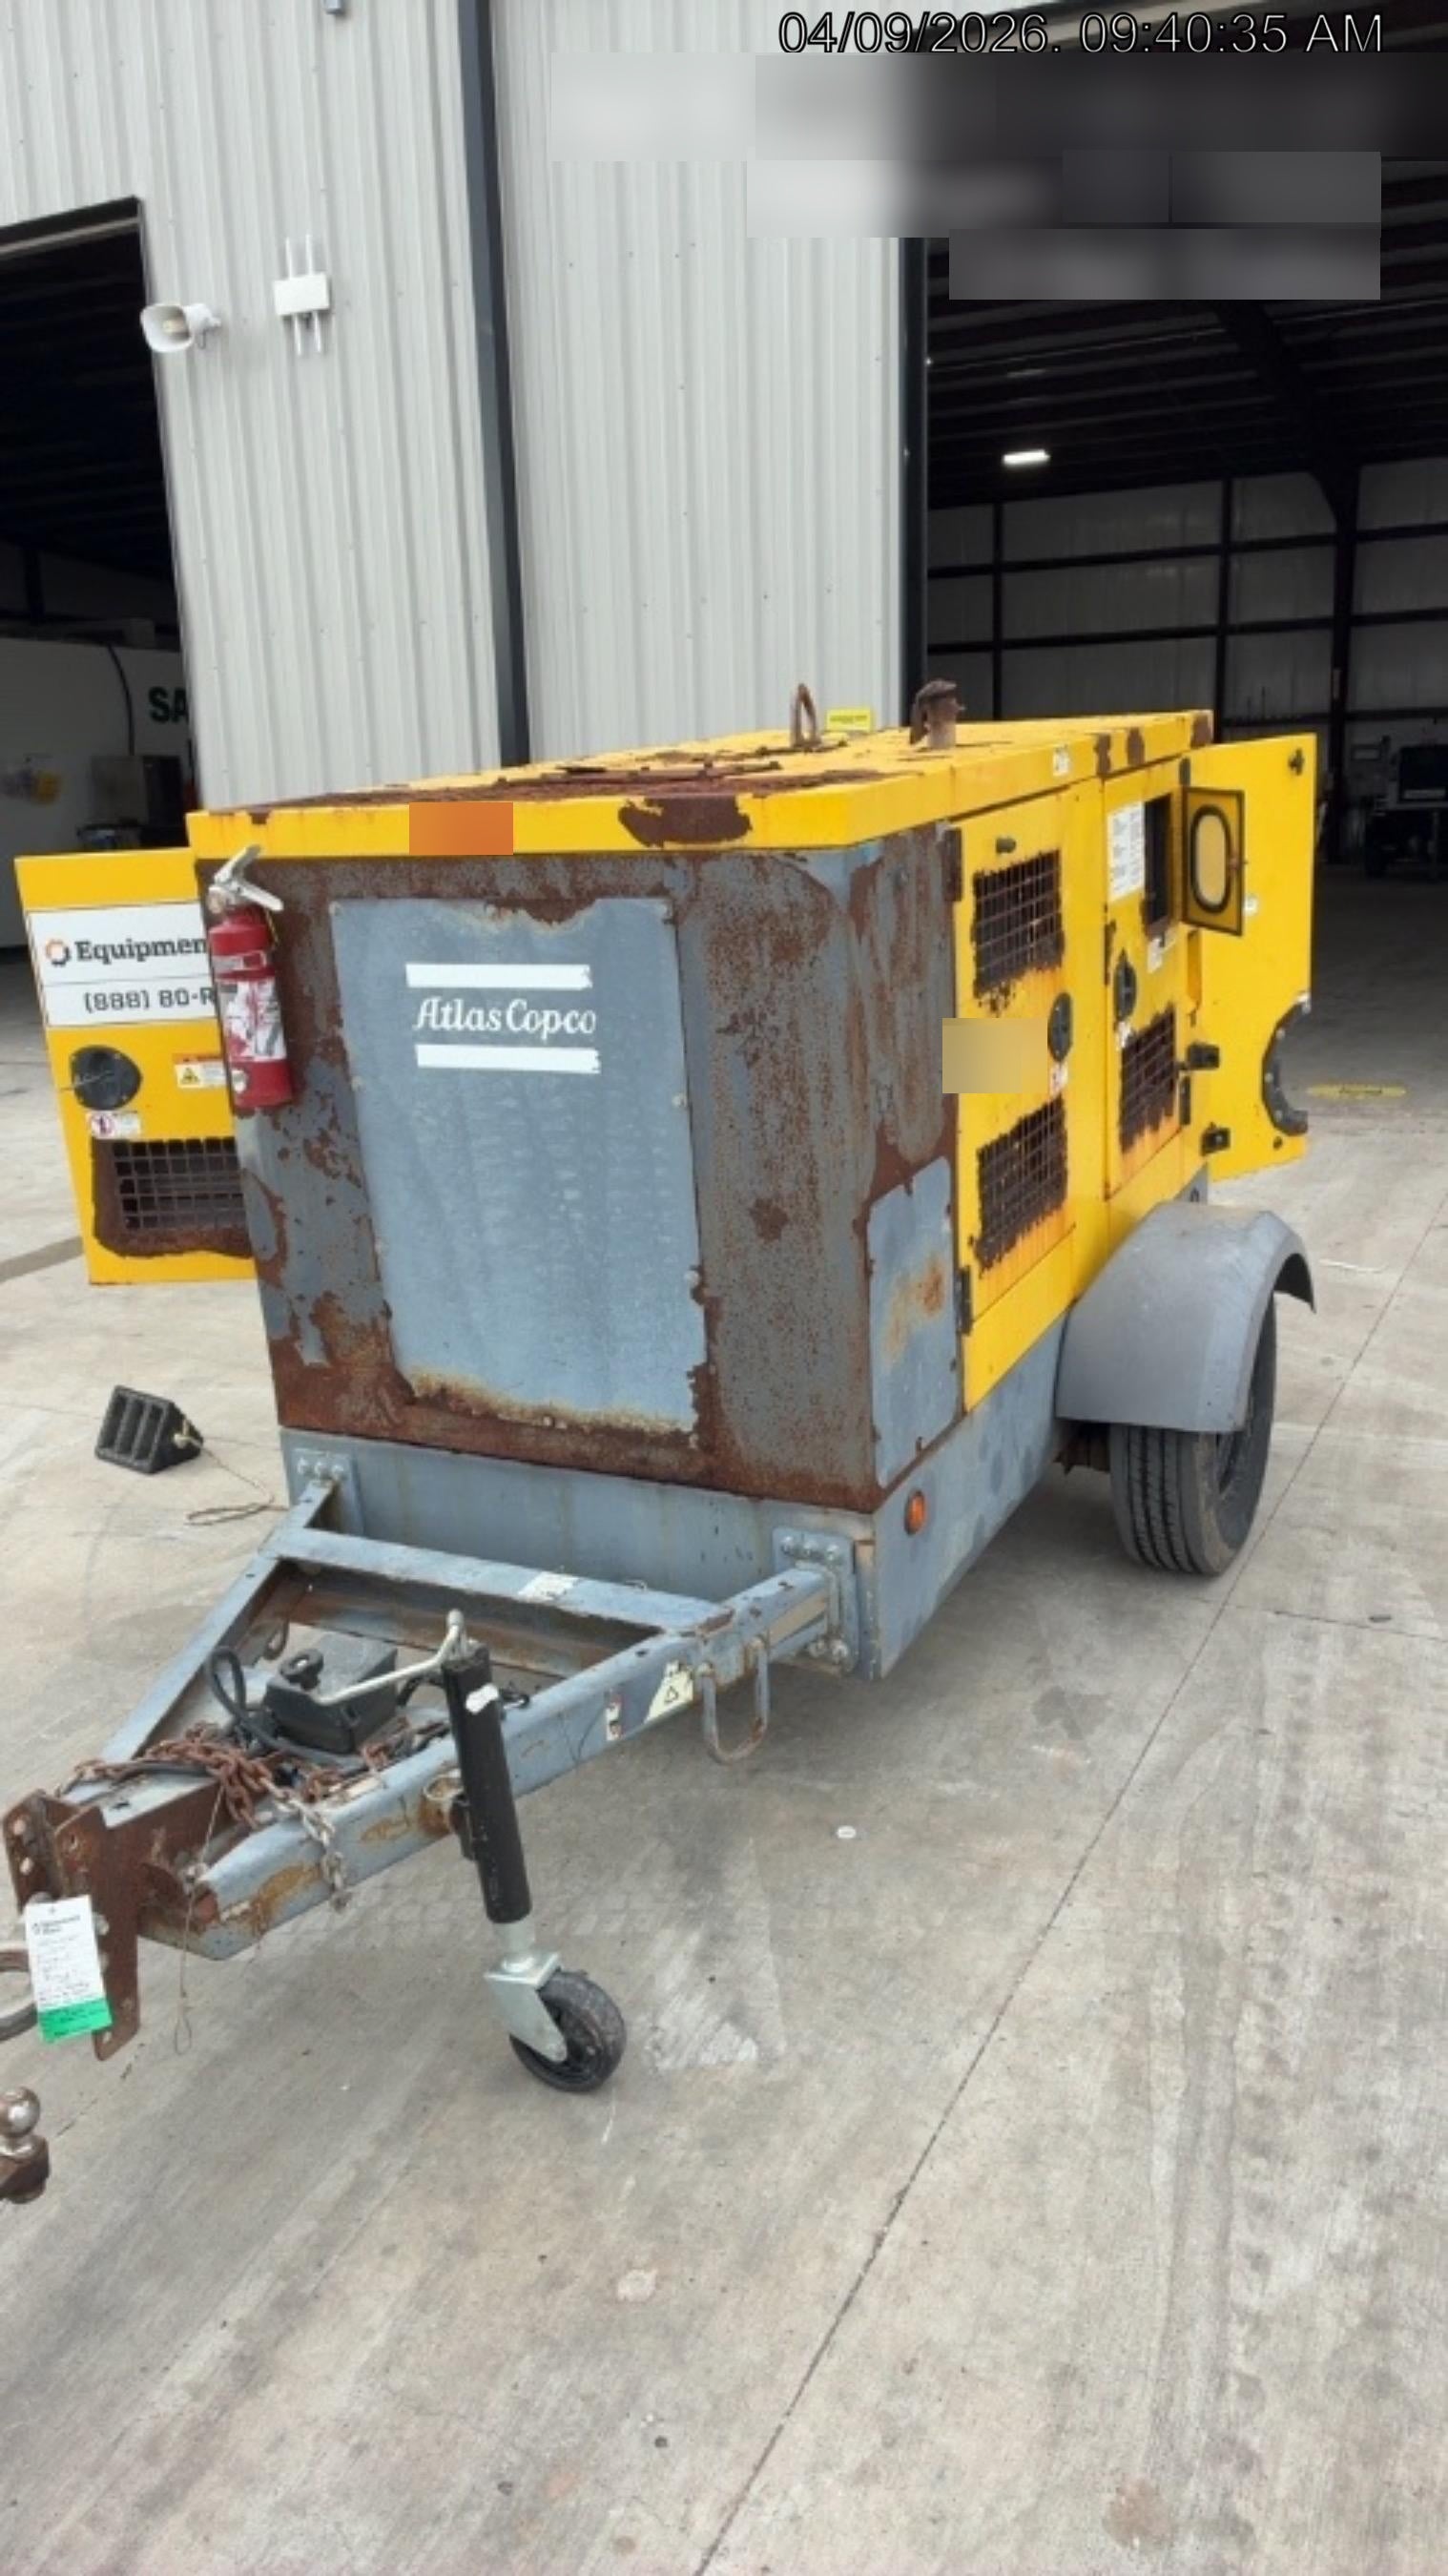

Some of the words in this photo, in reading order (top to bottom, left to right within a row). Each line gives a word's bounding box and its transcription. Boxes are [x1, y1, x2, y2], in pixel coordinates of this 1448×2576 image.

[84, 990, 150, 1013] (888)
[413, 996, 502, 1031] Atlas
[506, 998, 596, 1042] Copco
